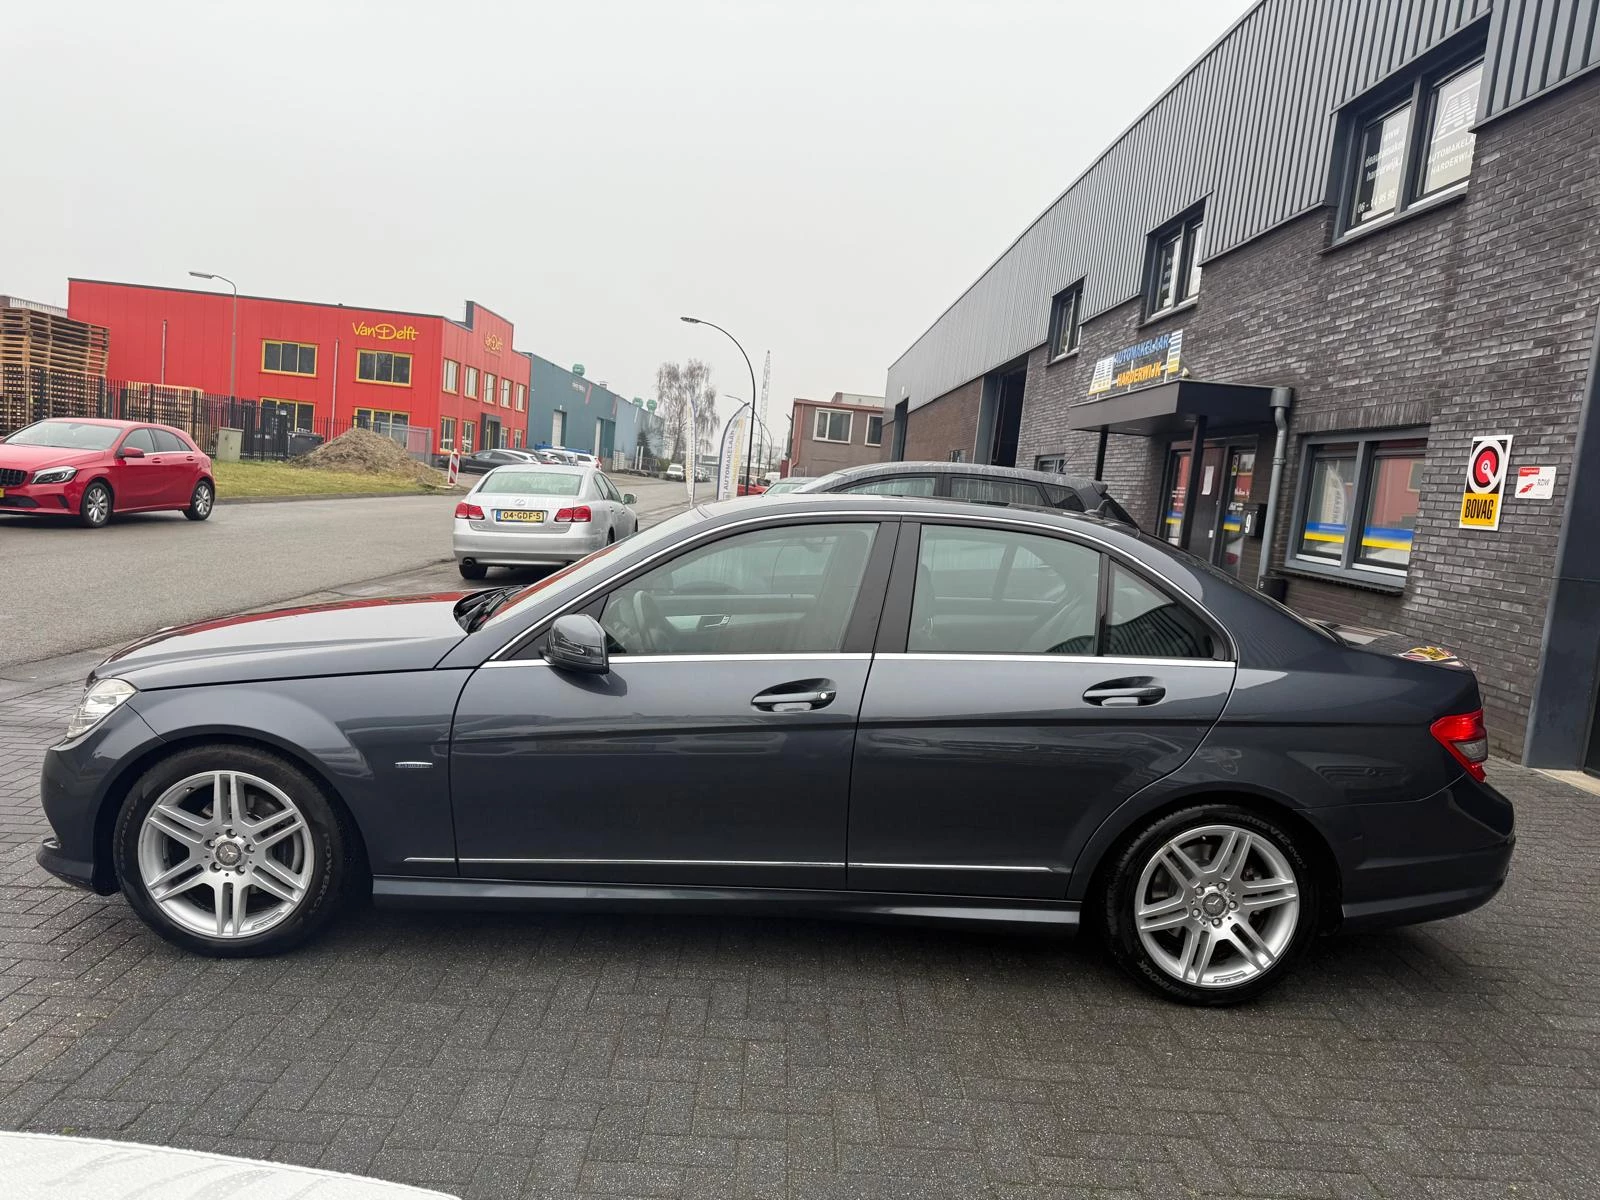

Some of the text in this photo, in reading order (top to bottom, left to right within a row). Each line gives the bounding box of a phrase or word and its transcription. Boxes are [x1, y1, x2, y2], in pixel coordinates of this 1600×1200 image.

[1116, 361, 1162, 388] HARDERWIJK
[503, 511, 541, 520] 04-GDF-5
[1464, 498, 1494, 520] BOVAG
